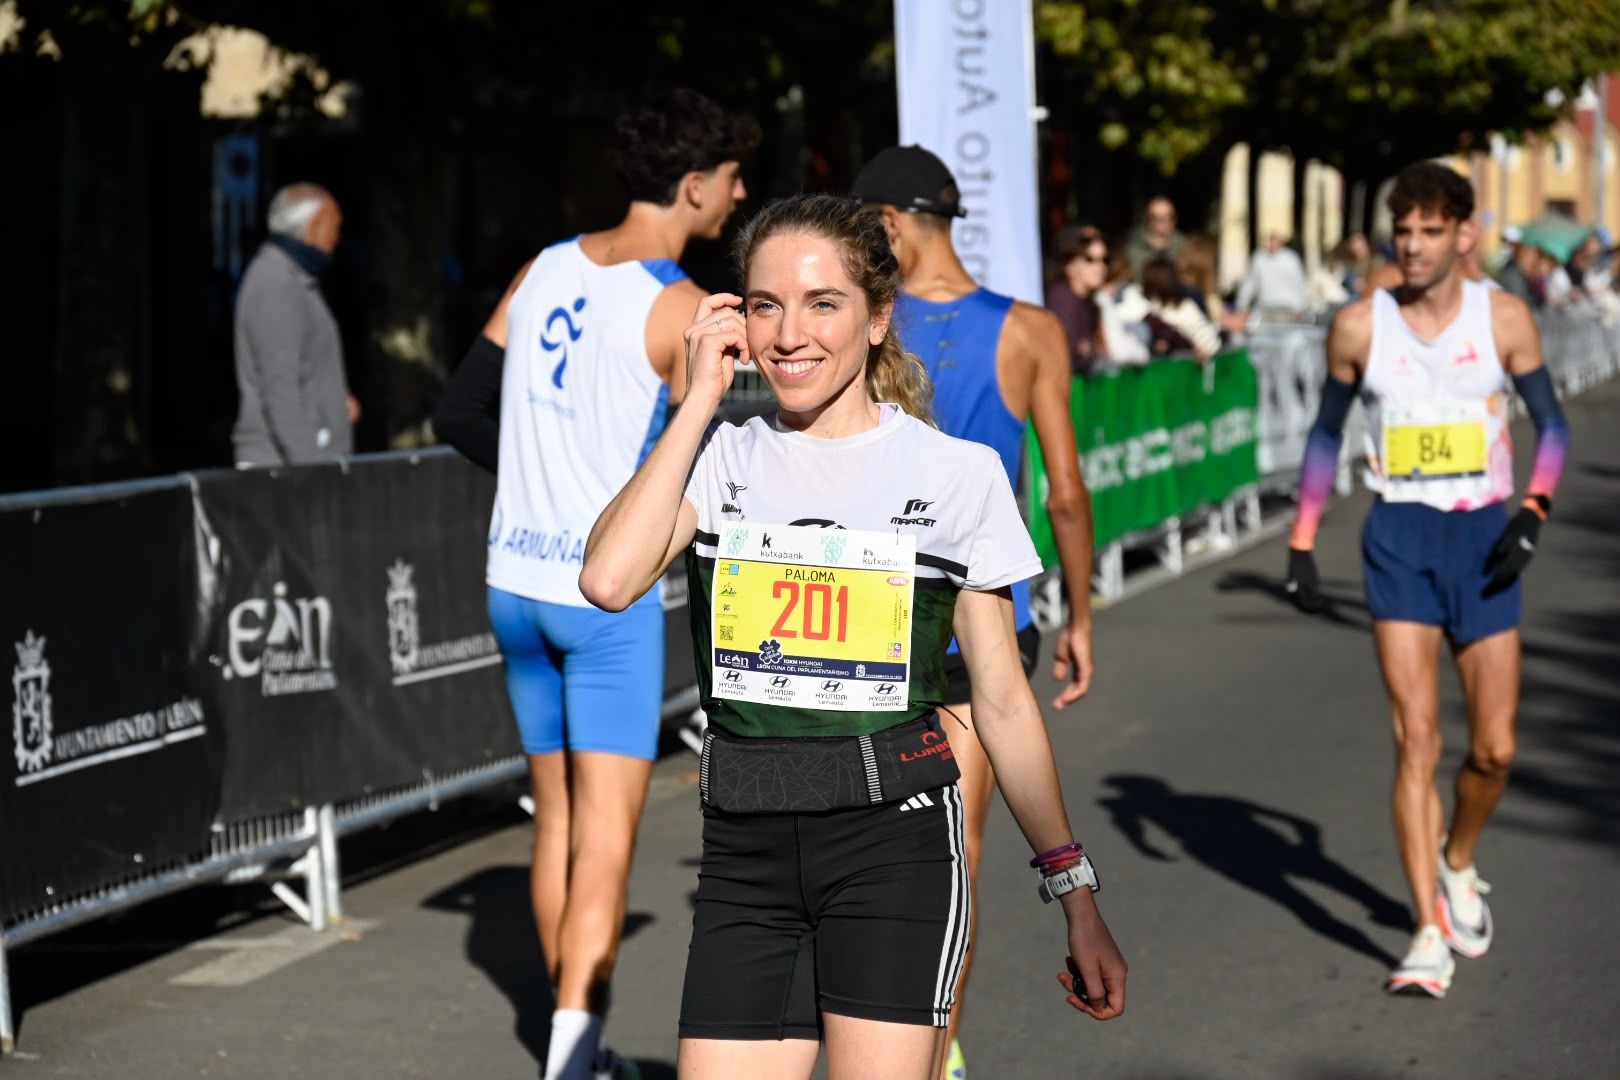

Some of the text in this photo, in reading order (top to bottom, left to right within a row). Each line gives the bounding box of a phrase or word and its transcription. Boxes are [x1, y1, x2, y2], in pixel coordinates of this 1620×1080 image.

[1419, 431, 1453, 463] 84
[890, 516, 937, 528] MARCET
[502, 526, 583, 566] ARMUÑA
[760, 549, 804, 560] kutxabank
[785, 568, 836, 583] PALOMA
[770, 580, 848, 643] 201
[798, 659, 823, 668] HYUNDAI
[771, 664, 786, 672] CUNA
[797, 667, 850, 676] PARLAMENTARISMO
[718, 682, 748, 691] HYUNDAI
[764, 688, 796, 696] HYUNDAI
[815, 693, 848, 701] HYUNDAI
